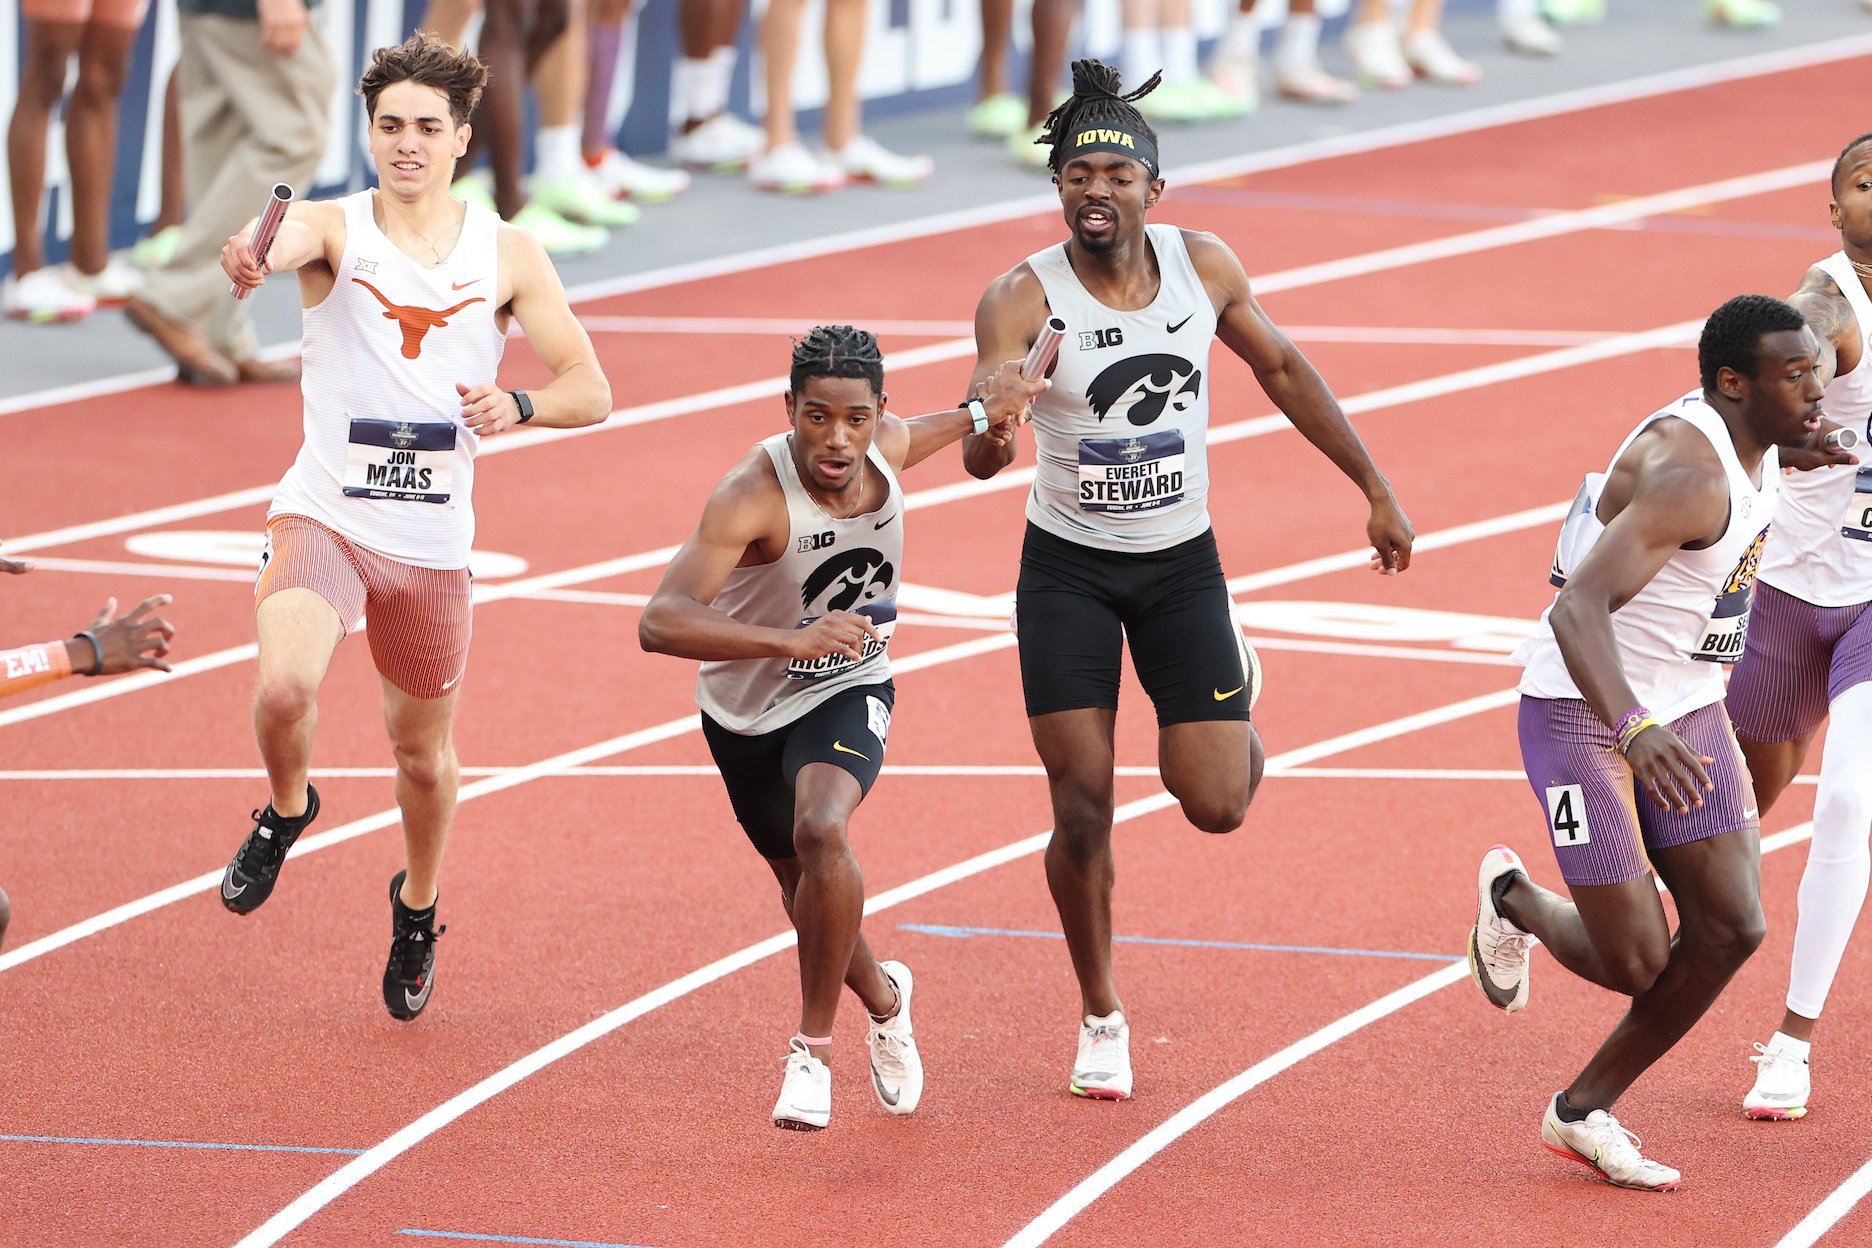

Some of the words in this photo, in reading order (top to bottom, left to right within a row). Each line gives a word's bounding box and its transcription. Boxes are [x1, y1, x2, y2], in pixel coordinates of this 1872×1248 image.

[1076, 129, 1135, 149] IOWA
[387, 451, 415, 465] JON
[366, 464, 432, 490] MAAS
[1106, 461, 1160, 480] EVERETT
[1080, 470, 1183, 502] STEWARD
[1554, 790, 1580, 840] 4
